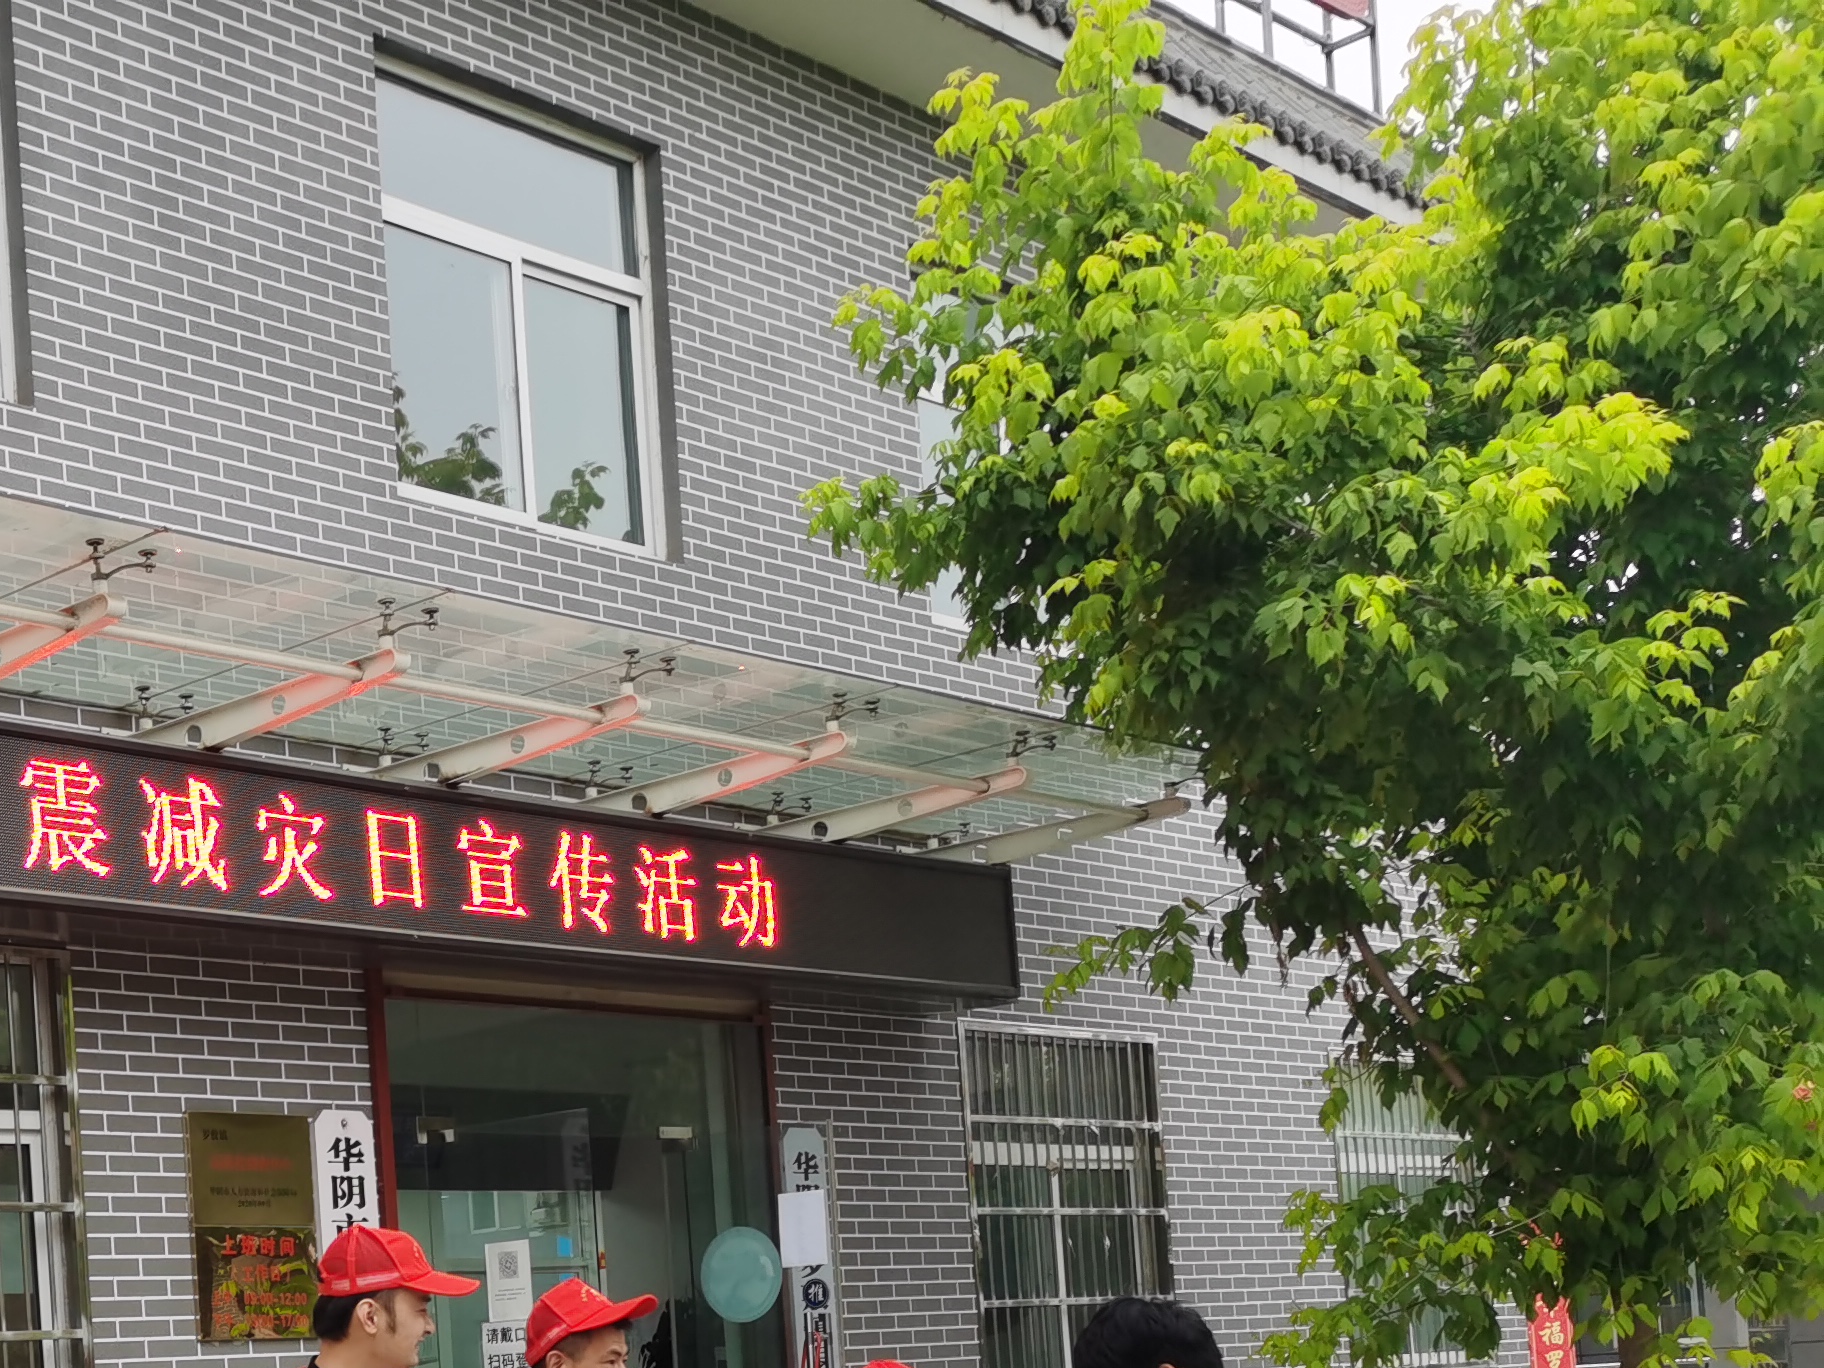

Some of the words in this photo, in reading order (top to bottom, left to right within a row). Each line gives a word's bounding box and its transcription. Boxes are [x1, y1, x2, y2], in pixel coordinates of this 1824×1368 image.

[793, 1151, 820, 1192] 华
[220, 1234, 296, 1257] 上班时间
[807, 1283, 825, 1303] 推
[486, 1326, 526, 1344] 请戴口
